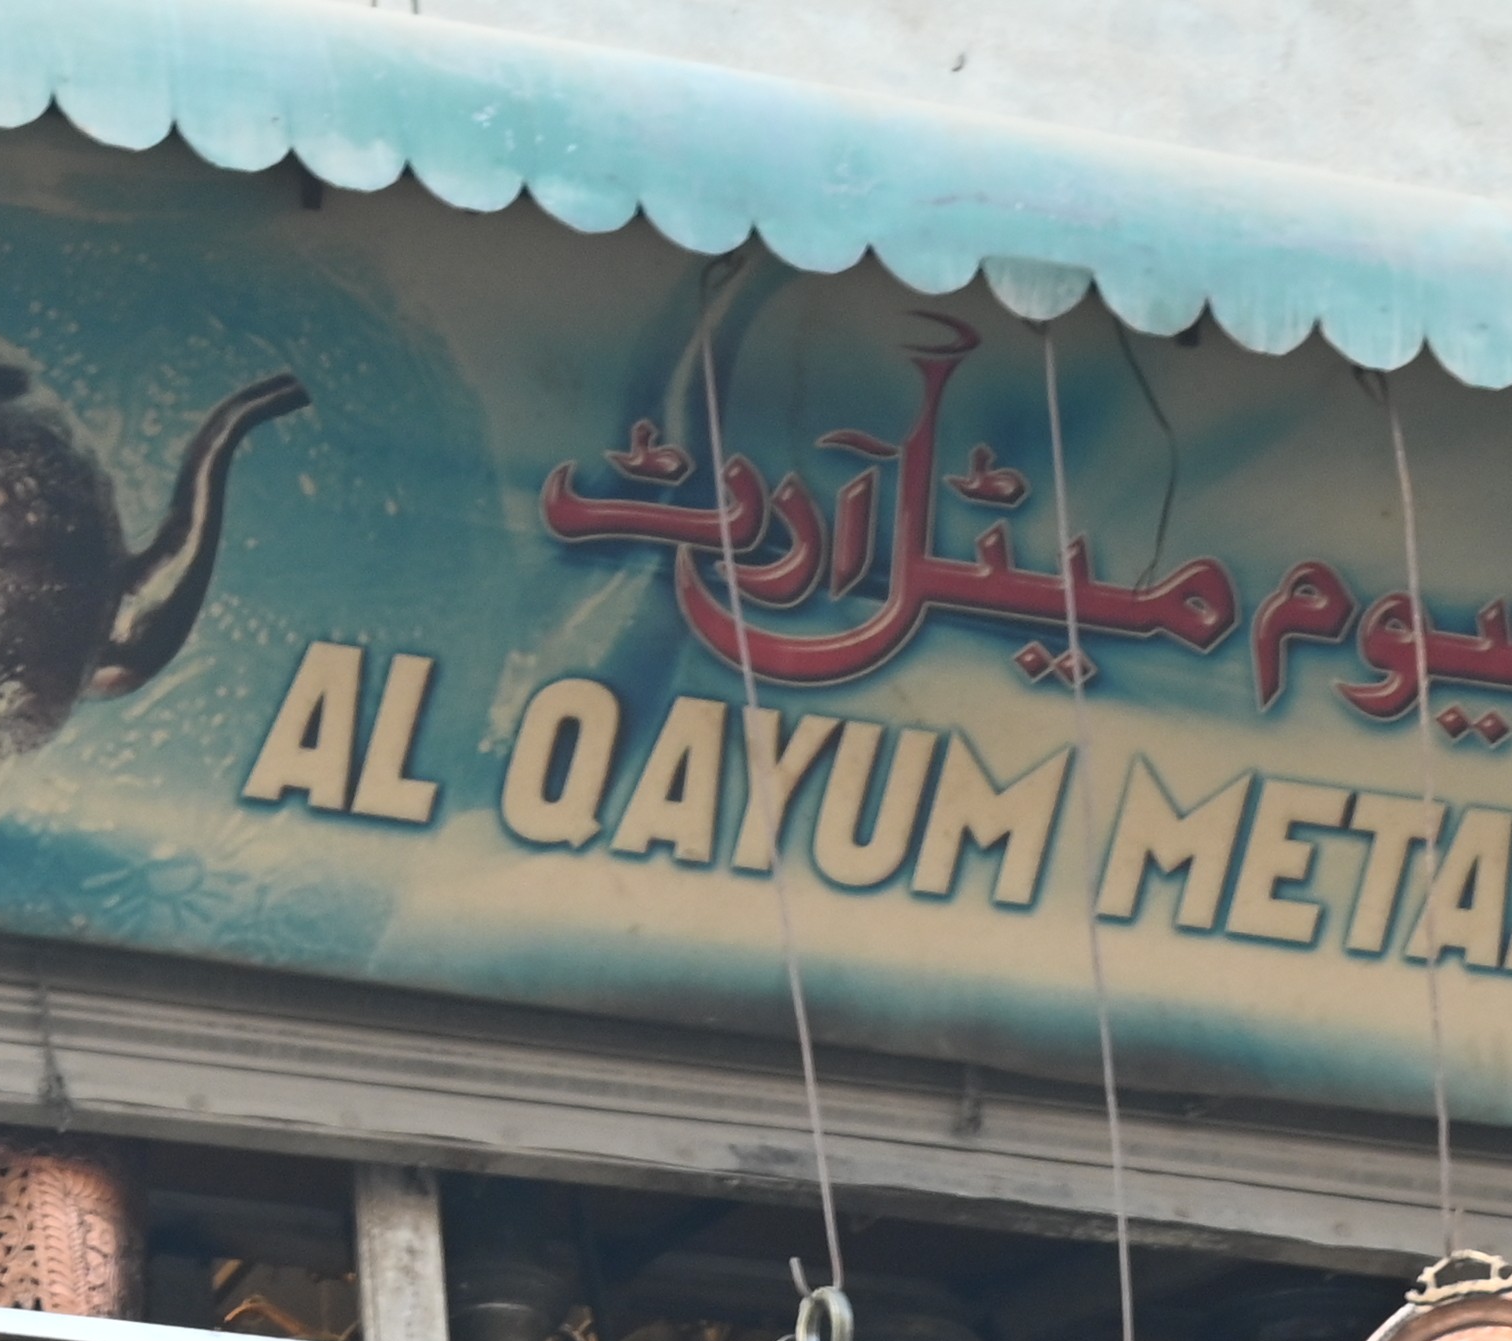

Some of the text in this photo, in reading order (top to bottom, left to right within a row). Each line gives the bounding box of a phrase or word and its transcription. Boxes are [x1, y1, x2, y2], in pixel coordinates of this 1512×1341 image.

[540, 418, 902, 608] آرٹ
[240, 639, 441, 826] AL
[498, 676, 1076, 910] QAYUM
